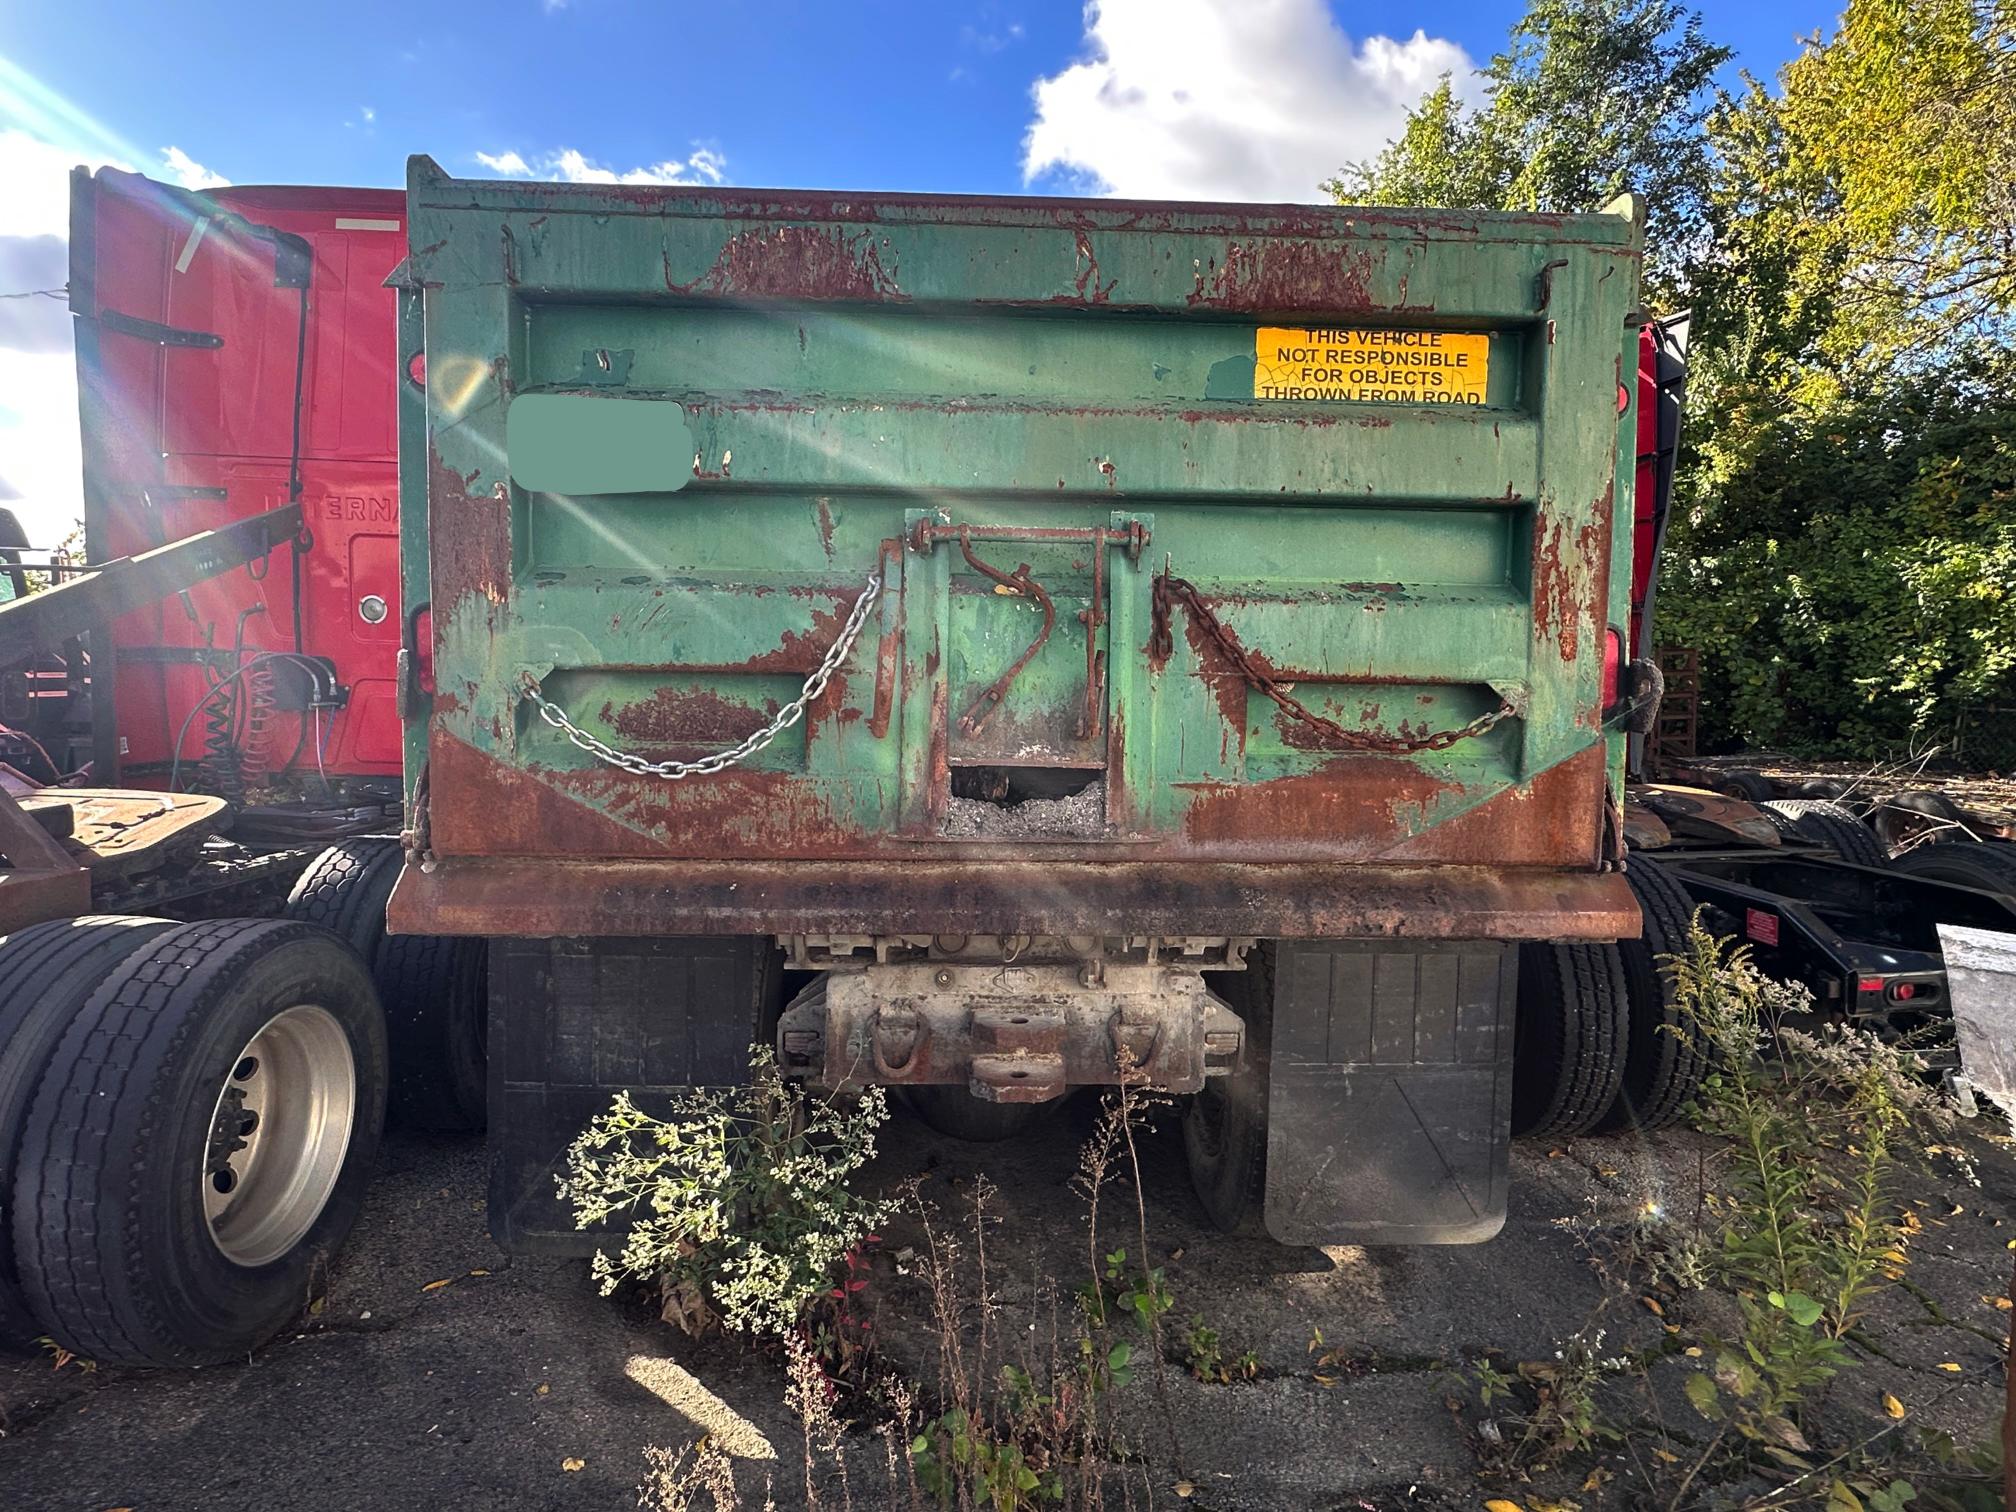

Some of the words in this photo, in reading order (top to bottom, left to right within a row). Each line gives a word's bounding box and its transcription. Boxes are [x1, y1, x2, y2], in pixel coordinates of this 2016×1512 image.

[1305, 329, 1350, 345] THIS
[1356, 330, 1443, 347] VEHICLE
[1277, 347, 1320, 363] NOT
[1325, 349, 1469, 368] RESPONSIBLE
[1301, 367, 1343, 383] FOR
[1349, 369, 1444, 387] OBJECTS
[1261, 386, 1352, 401] THROWN
[1359, 388, 1416, 402] FROM
[1422, 390, 1481, 405] ROAD
